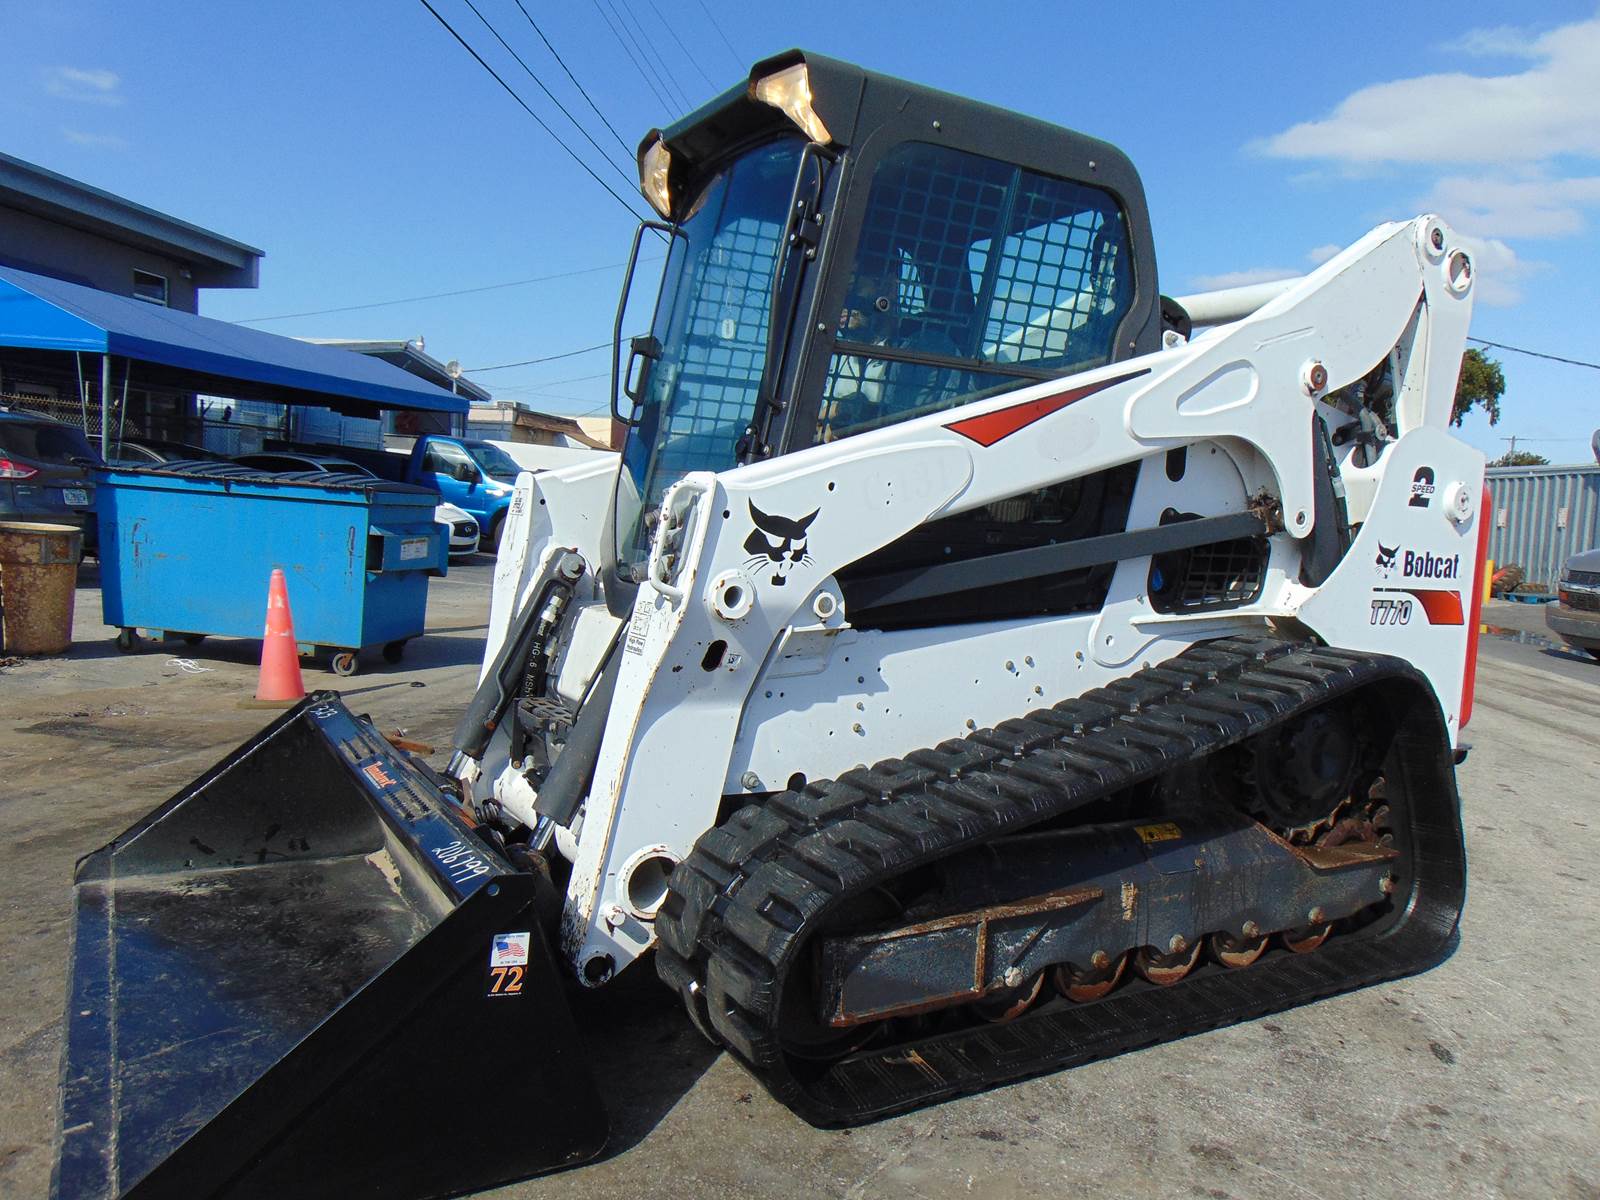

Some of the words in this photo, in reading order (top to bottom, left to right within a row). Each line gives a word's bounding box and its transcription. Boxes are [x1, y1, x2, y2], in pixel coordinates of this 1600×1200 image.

[1411, 484, 1435, 494] SPEED
[1403, 550, 1459, 579] Bobcat
[1370, 600, 1412, 625] T770
[490, 966, 523, 993] 72
